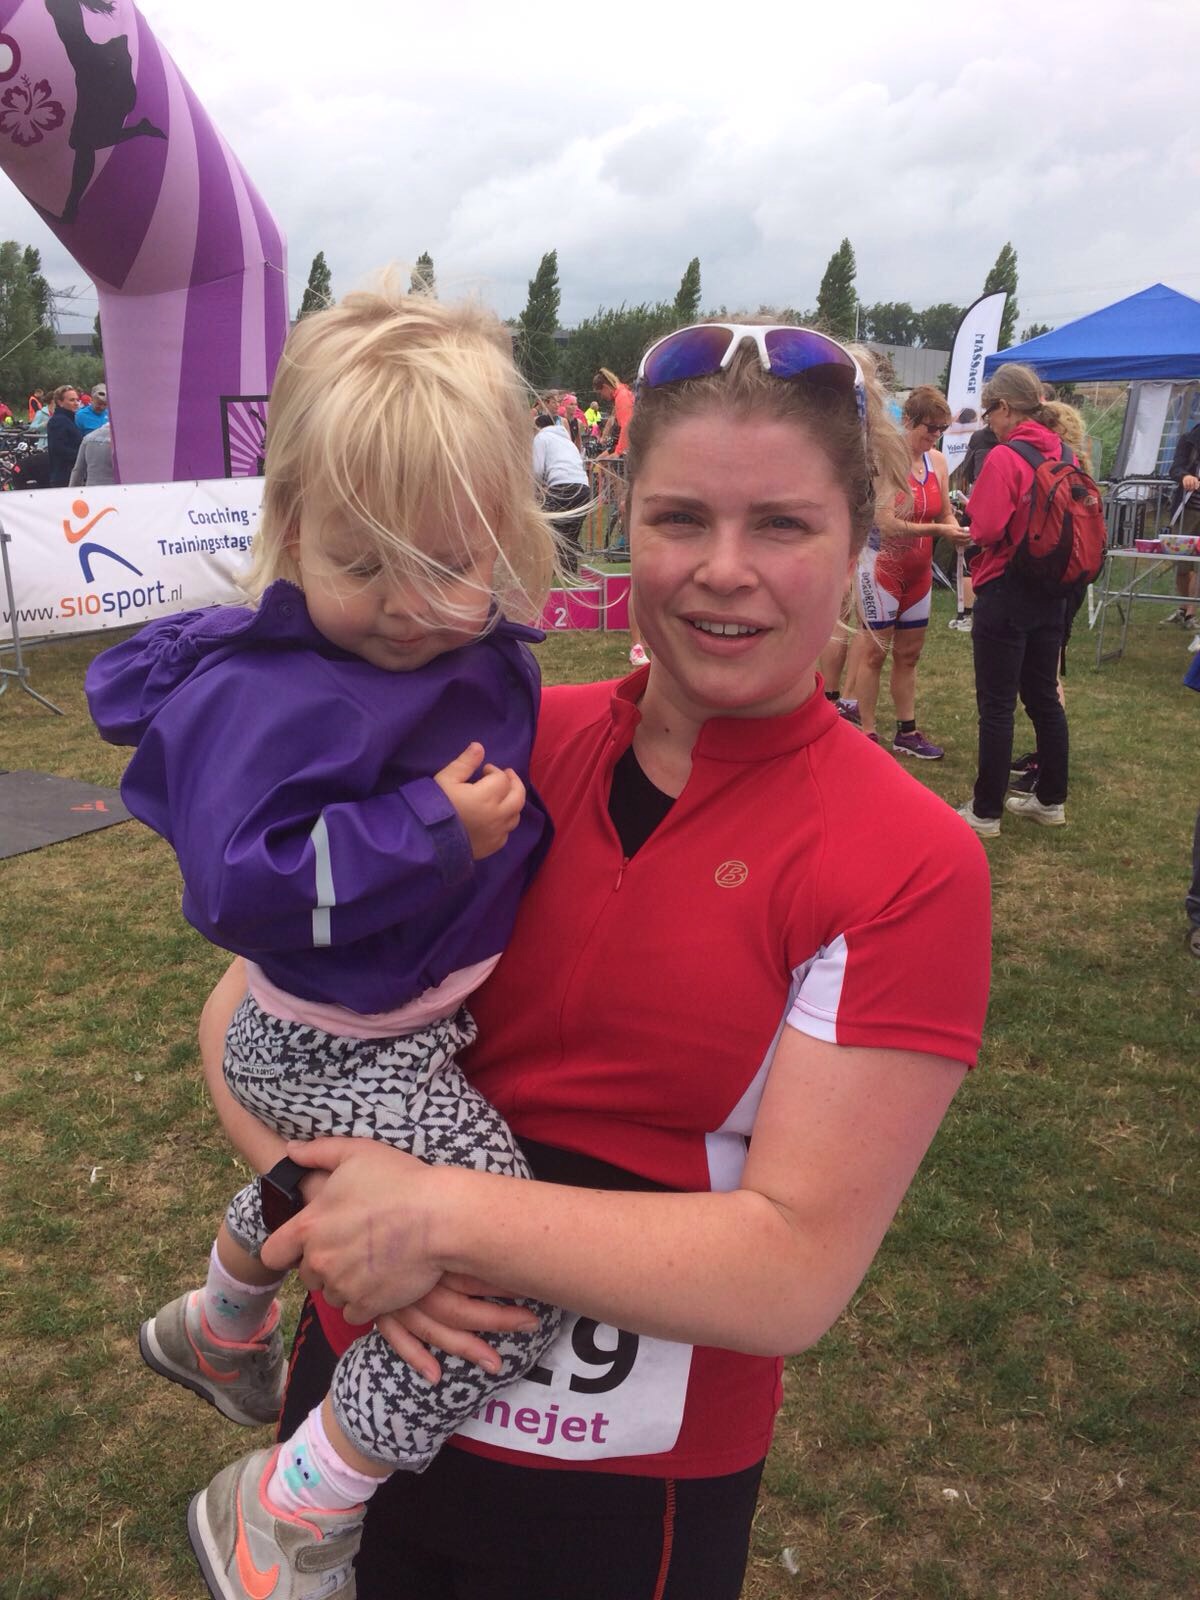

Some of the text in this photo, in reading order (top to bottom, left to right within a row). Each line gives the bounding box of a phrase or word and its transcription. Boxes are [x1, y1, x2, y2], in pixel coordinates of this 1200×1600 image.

[967, 333, 985, 394] MASSAGE
[188, 508, 250, 526] Coaching
[554, 607, 567, 627] 2
[524, 1316, 639, 1394] 9
[472, 1399, 610, 1445] nejet
